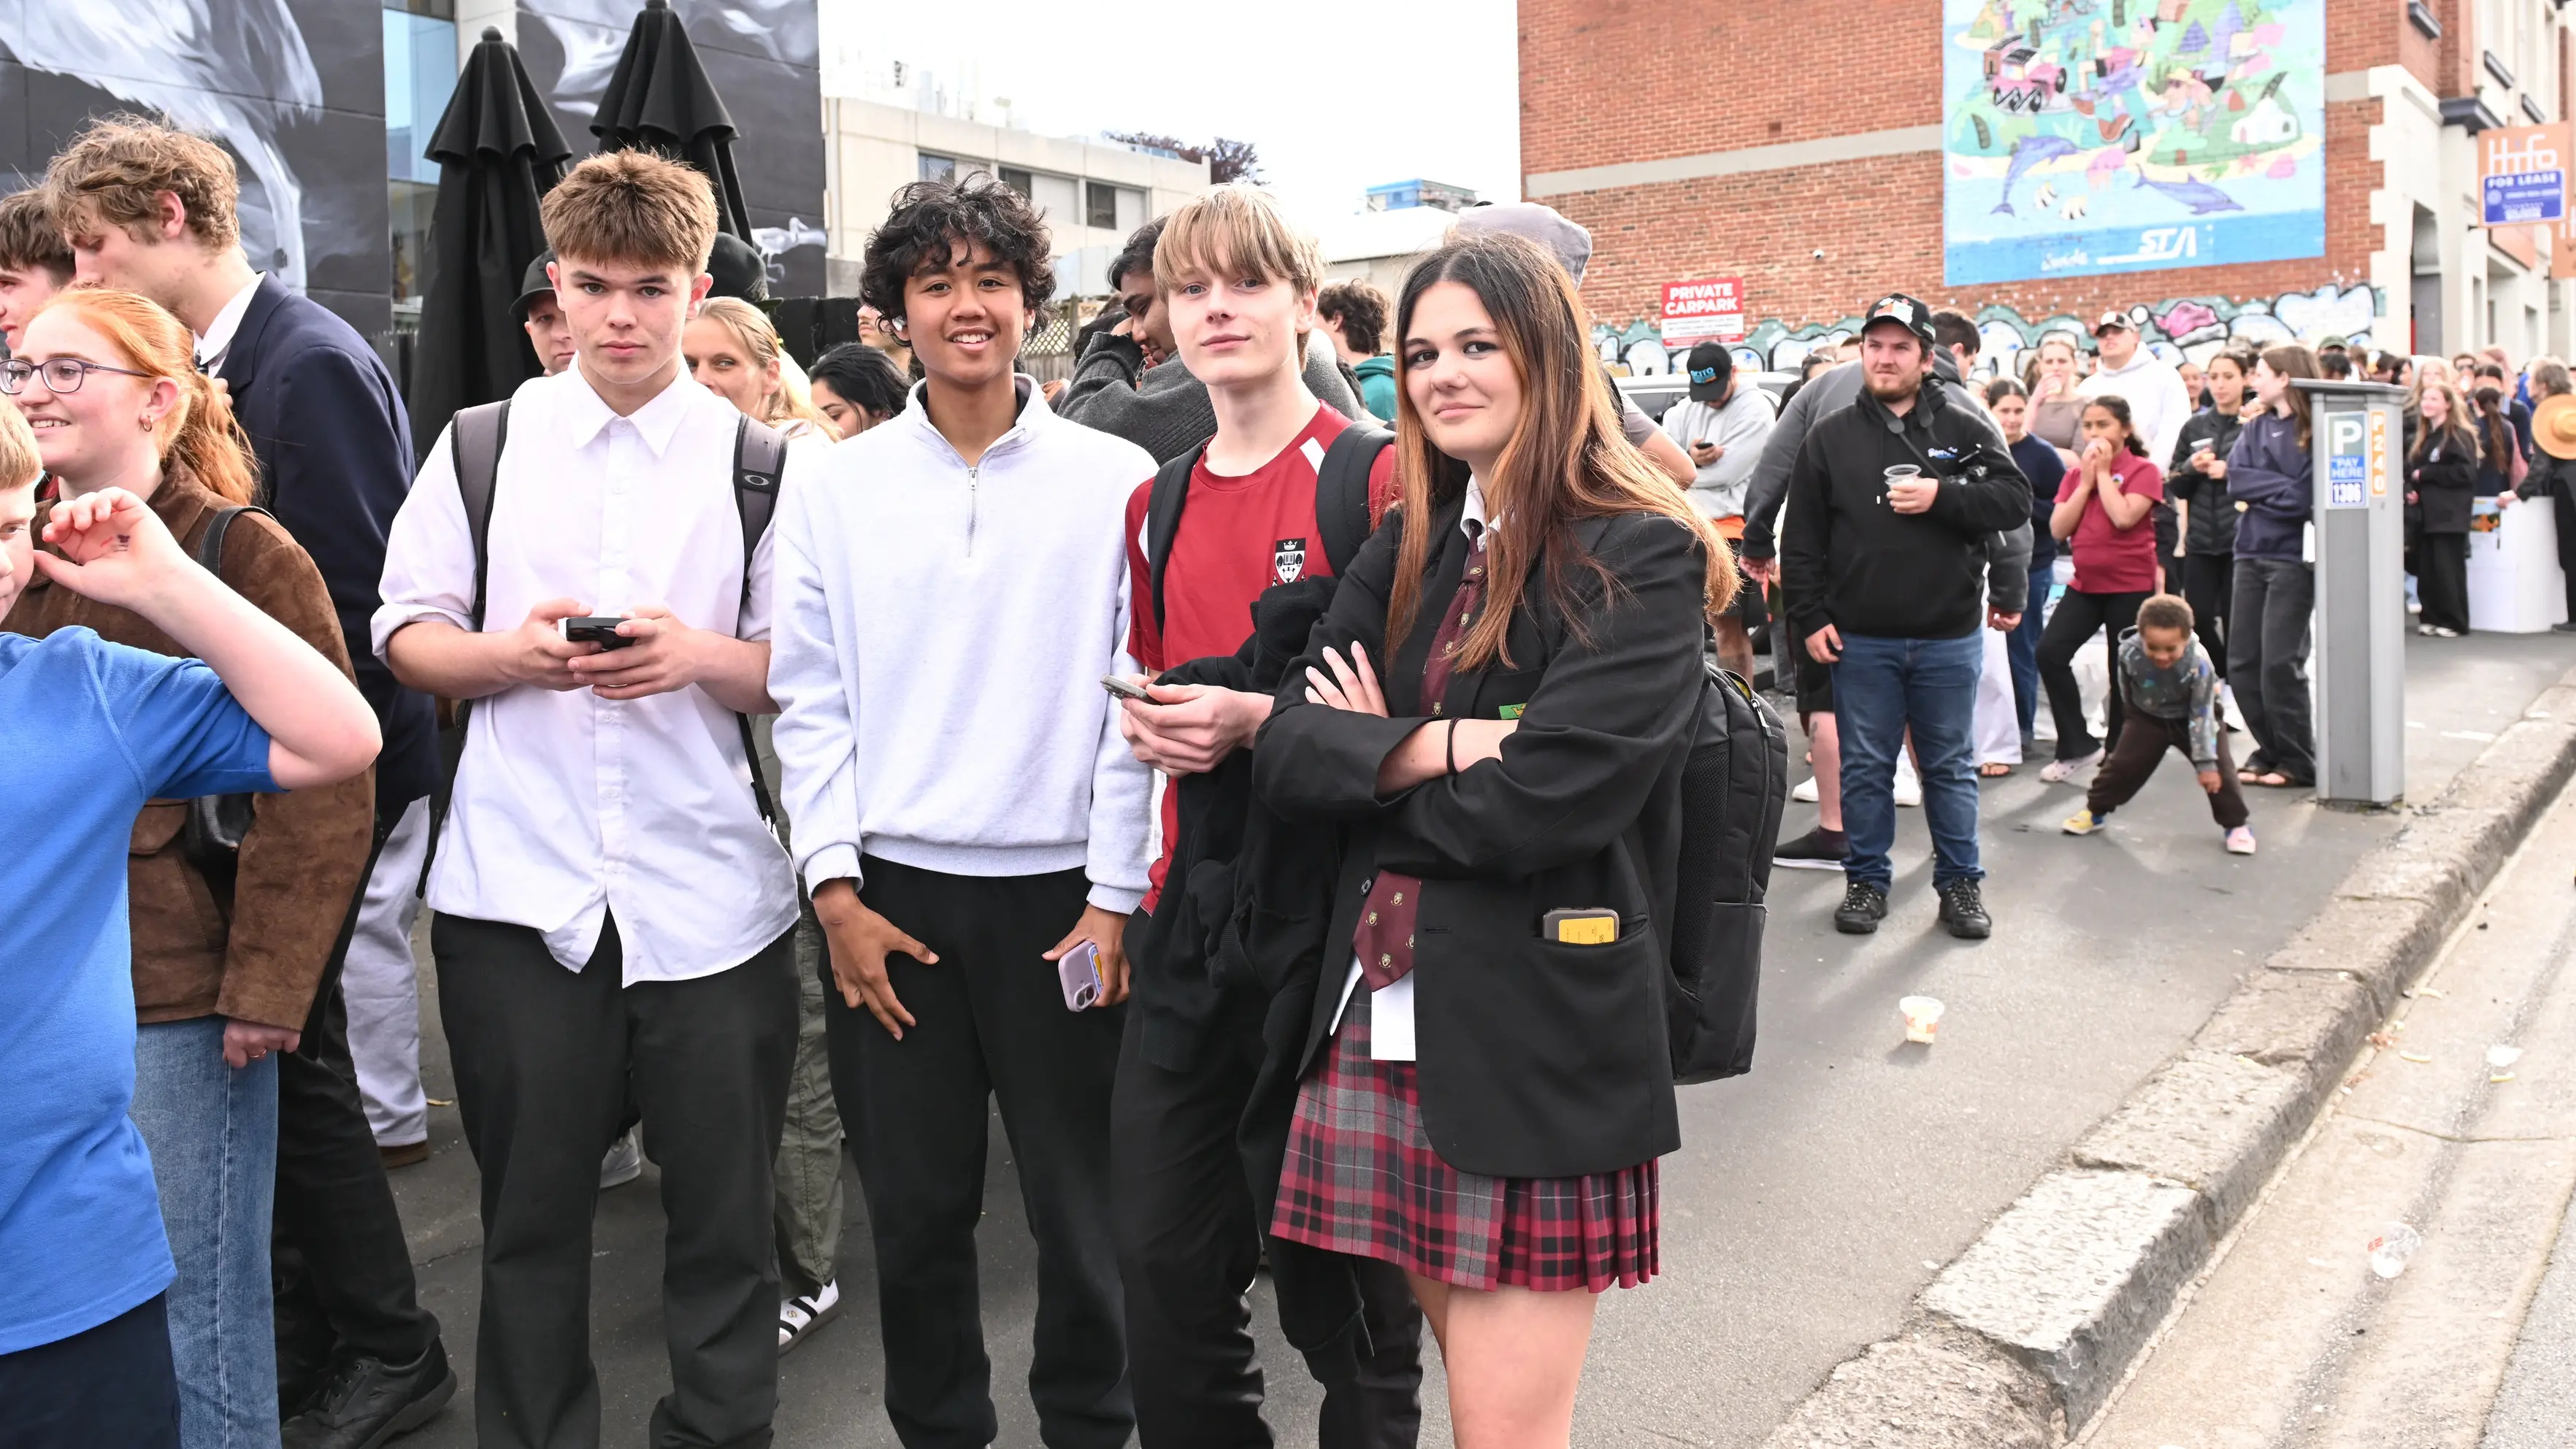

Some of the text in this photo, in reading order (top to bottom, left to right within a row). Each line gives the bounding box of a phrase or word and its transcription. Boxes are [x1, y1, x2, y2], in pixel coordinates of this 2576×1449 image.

[2487, 172, 2557, 188] FOR LEASE
[1669, 283, 1733, 300] PRIVATE
[1665, 297, 1738, 315] CARPARK
[2334, 420, 2363, 456] P
[2337, 458, 2359, 468] PAY
[2331, 467, 2364, 479] HERE
